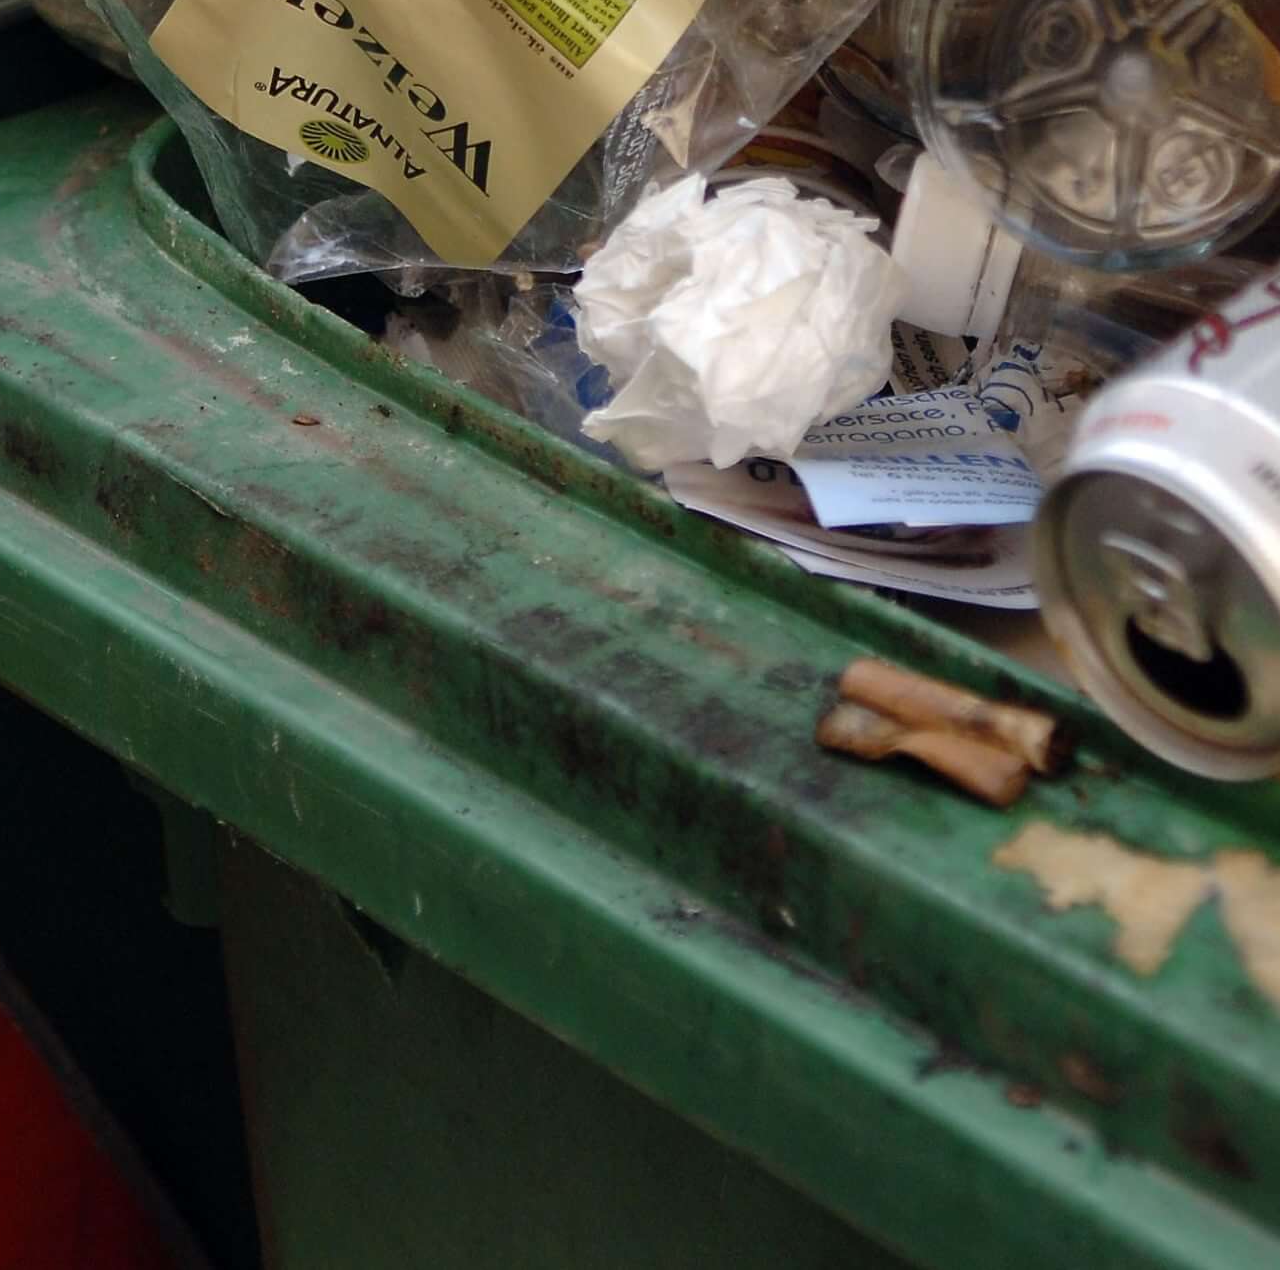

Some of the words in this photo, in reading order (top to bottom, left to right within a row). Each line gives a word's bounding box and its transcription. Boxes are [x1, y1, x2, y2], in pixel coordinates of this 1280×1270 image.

[535, 10, 586, 60] Alnatura
[547, 54, 575, 82] aus
[855, 387, 970, 410] nische
